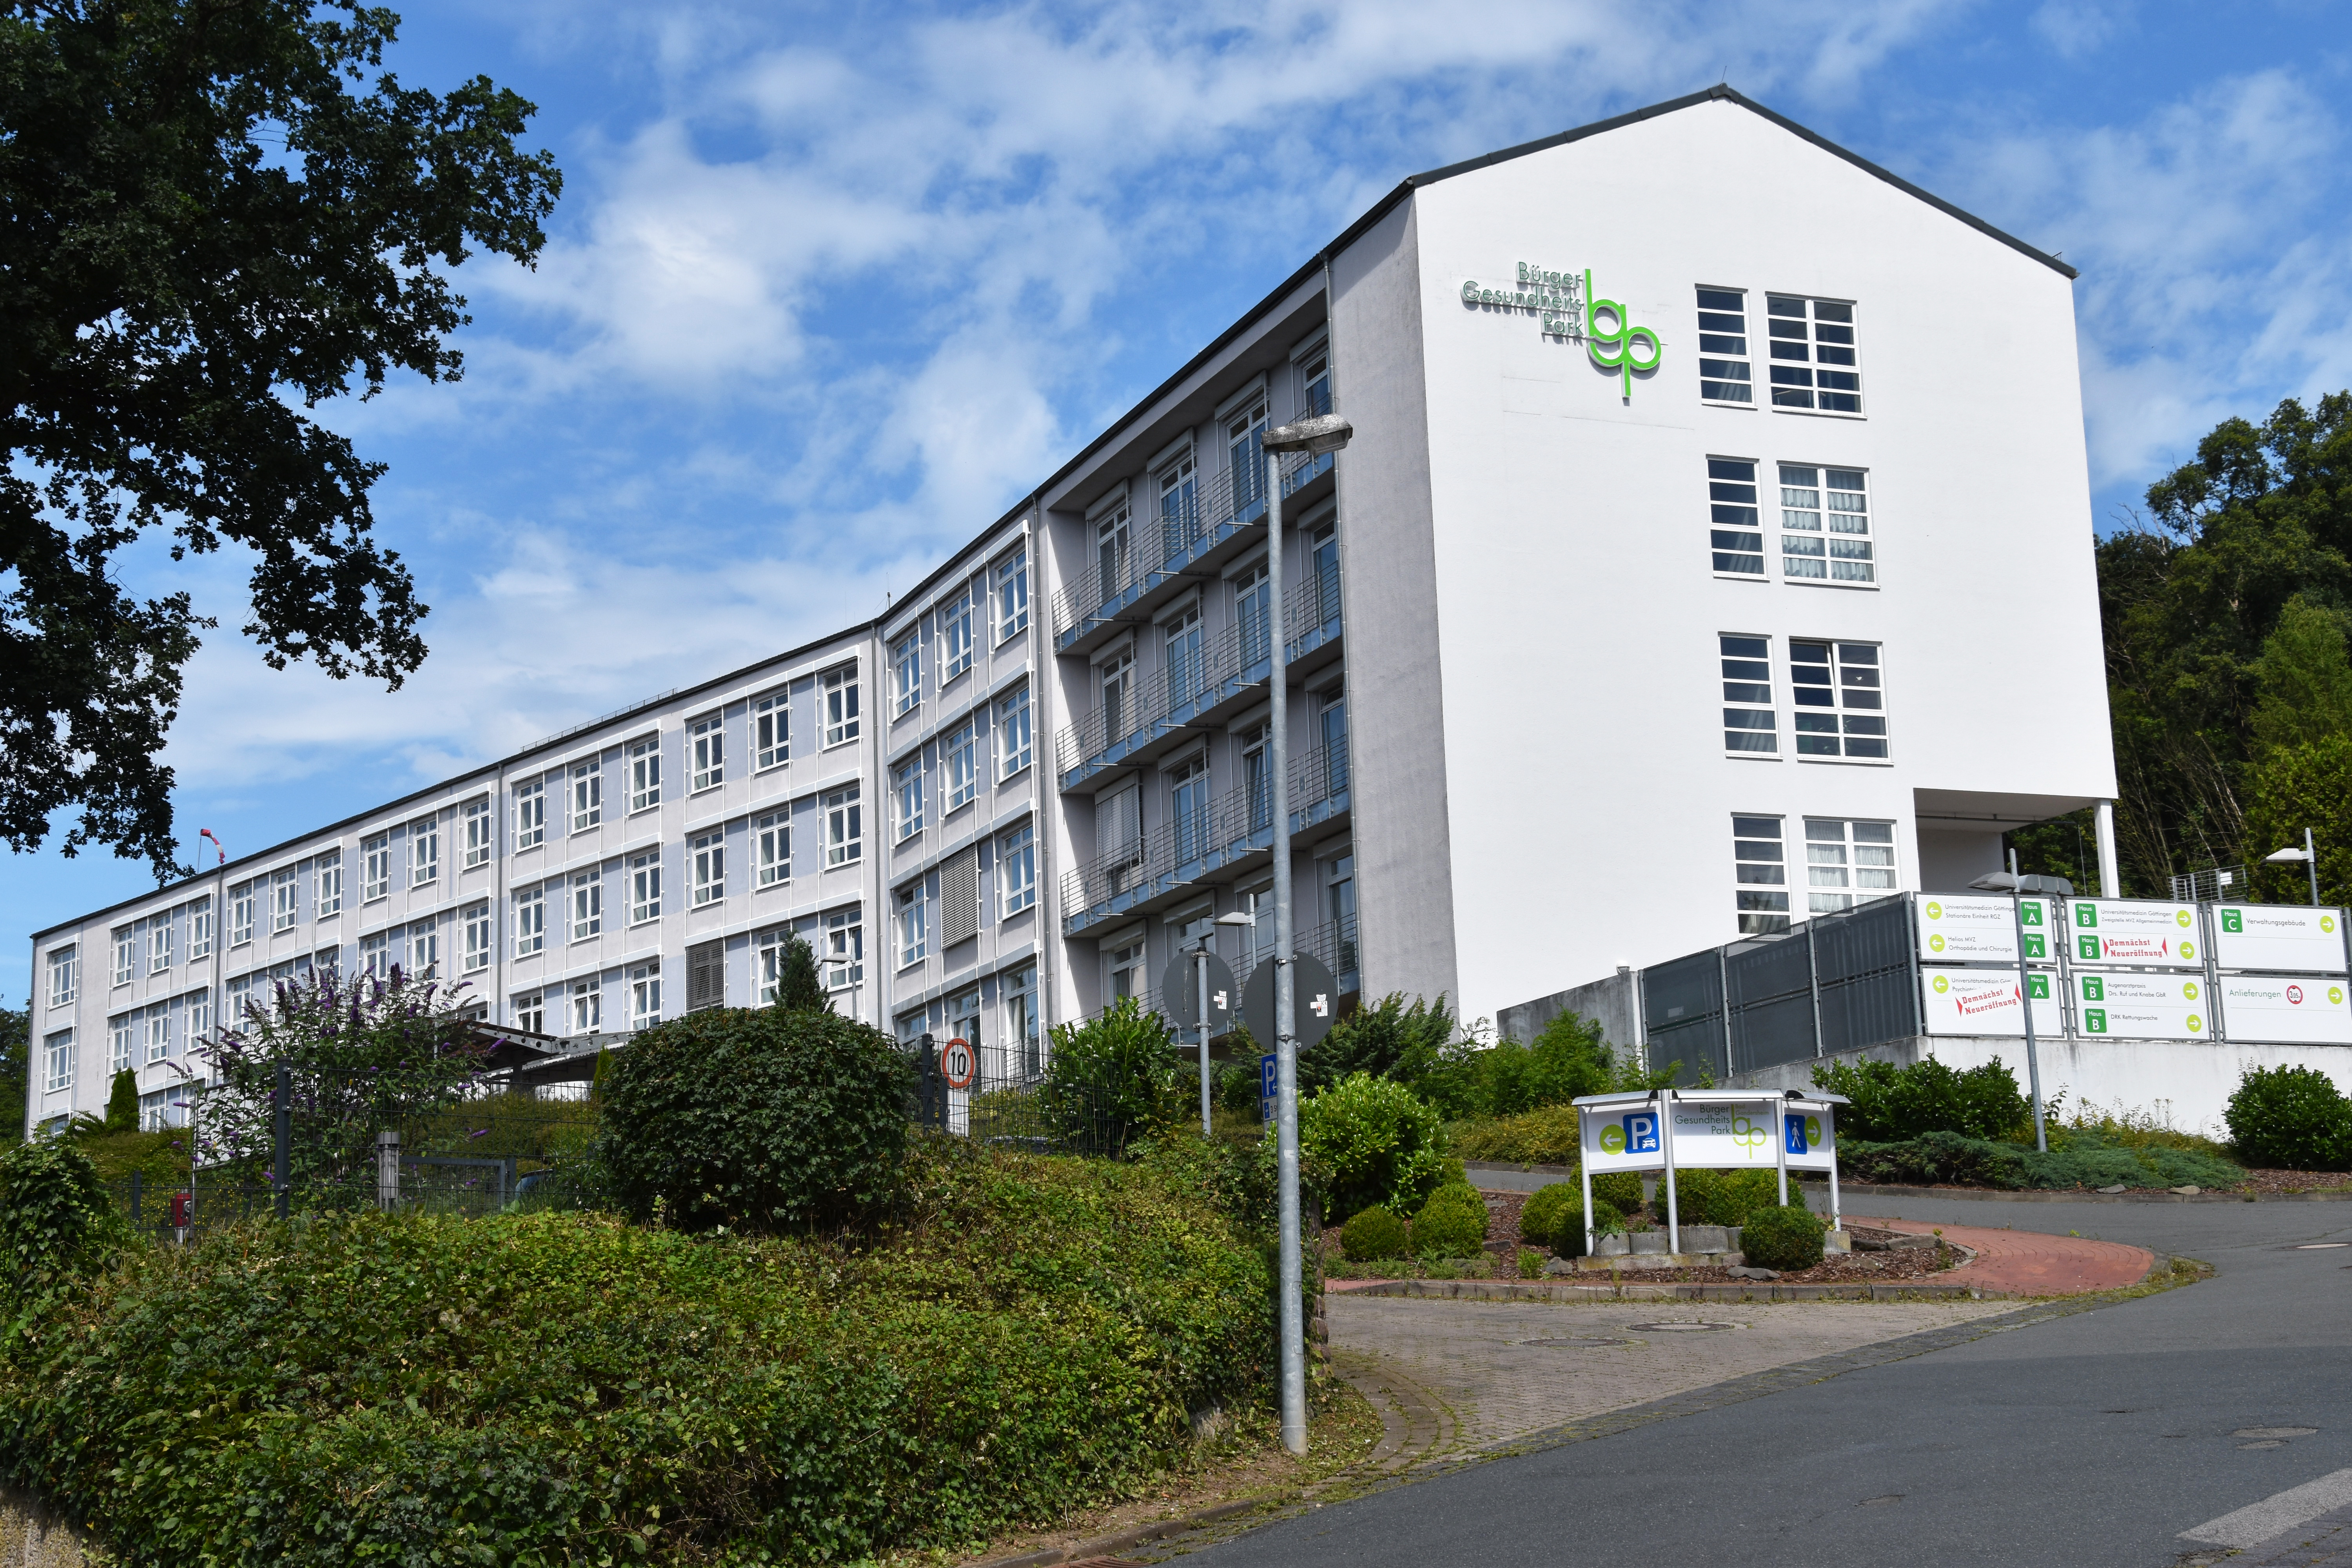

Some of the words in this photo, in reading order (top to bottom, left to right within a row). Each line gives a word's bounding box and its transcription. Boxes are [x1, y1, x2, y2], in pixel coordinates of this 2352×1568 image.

[1519, 261, 1581, 290] Bürger
[1463, 281, 1582, 310] Gesundheits
[1544, 313, 1583, 335] Park
[2028, 912, 2037, 923] A
[2083, 914, 2090, 925] B
[2228, 919, 2237, 930] C
[2031, 944, 2040, 955] A
[2085, 946, 2093, 956] B
[2111, 949, 2162, 958] Neueröffnung
[2034, 985, 2044, 996] A
[2089, 987, 2096, 998] B
[2229, 989, 2281, 999] Anlieferungen
[1962, 989, 2003, 1004] Demnächst
[1965, 998, 2017, 1014] Neueröffnung
[2092, 1019, 2100, 1030] B
[951, 1051, 966, 1074] 10
[1265, 1061, 1276, 1096] P
[1700, 1104, 1729, 1115] Bürger
[1675, 1115, 1730, 1124] Gesundheits
[1631, 1118, 1652, 1149] P
[1711, 1125, 1731, 1134] Park
